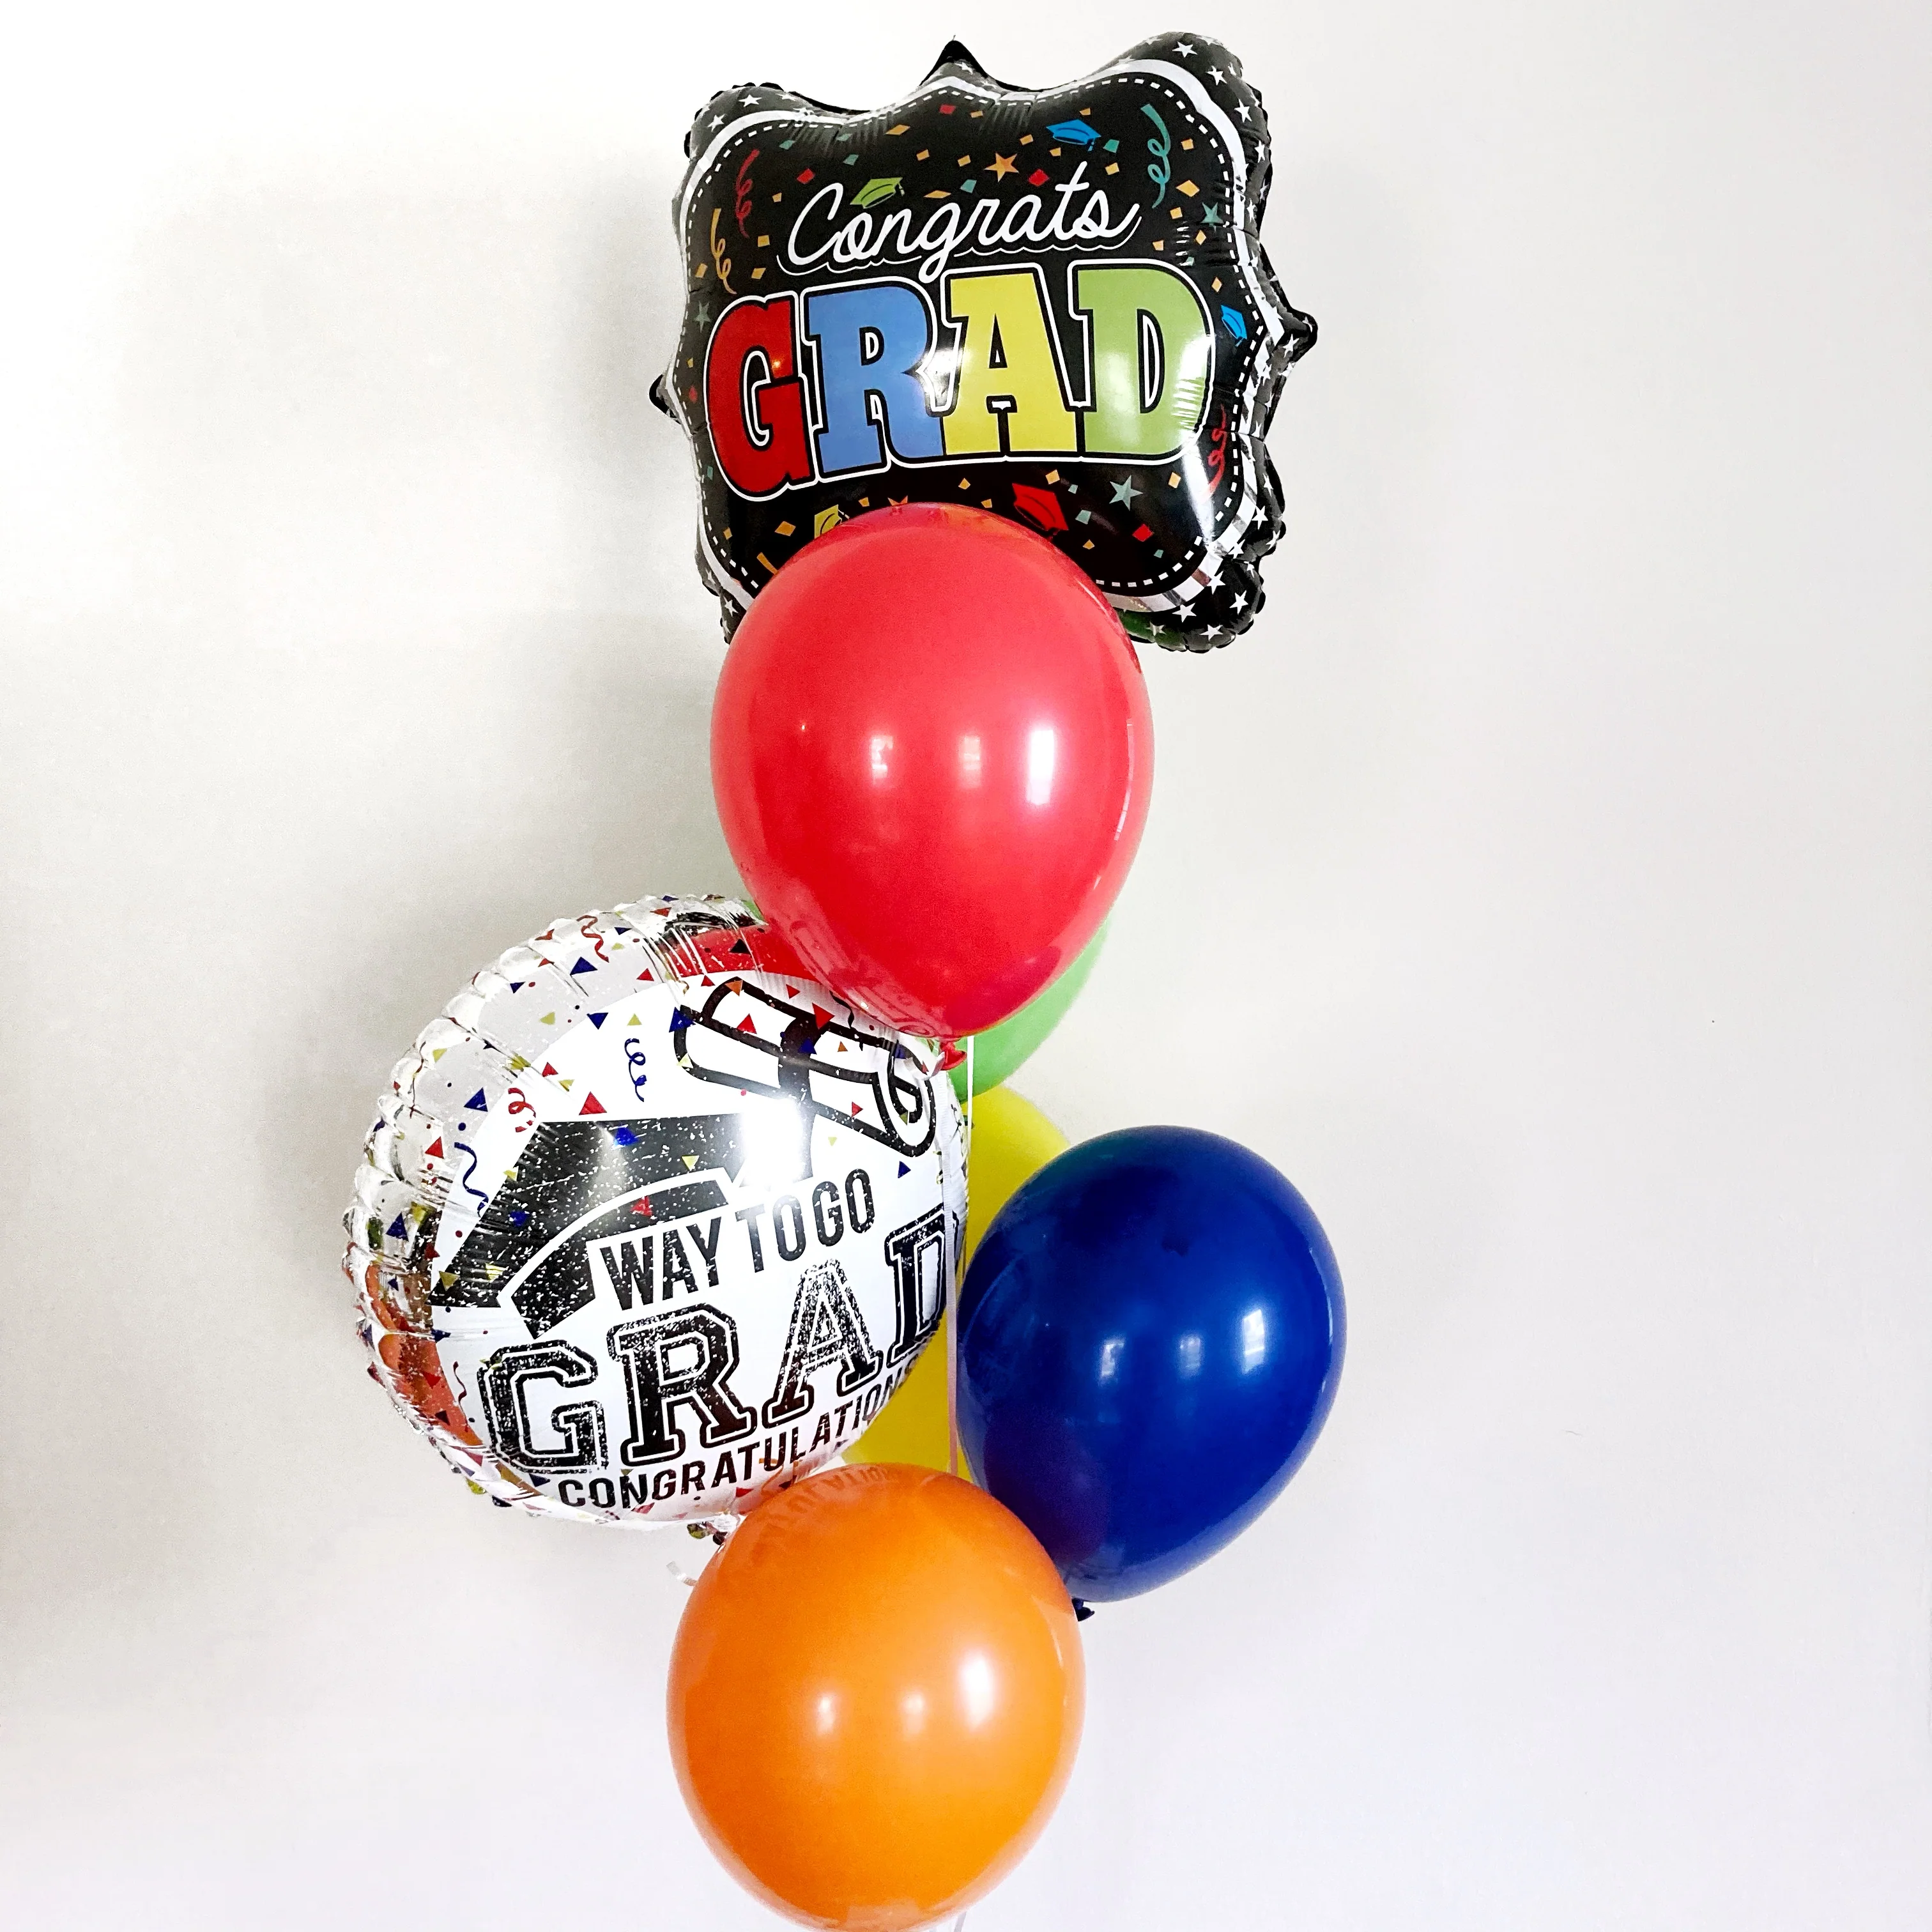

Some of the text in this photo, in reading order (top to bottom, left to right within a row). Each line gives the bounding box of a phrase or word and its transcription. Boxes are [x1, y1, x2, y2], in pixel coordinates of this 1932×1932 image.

[785, 162, 1139, 279] Congrats
[705, 262, 1213, 499] GRAD
[601, 1169, 874, 1310] WAY TO GO
[477, 1202, 960, 1475] GRAD
